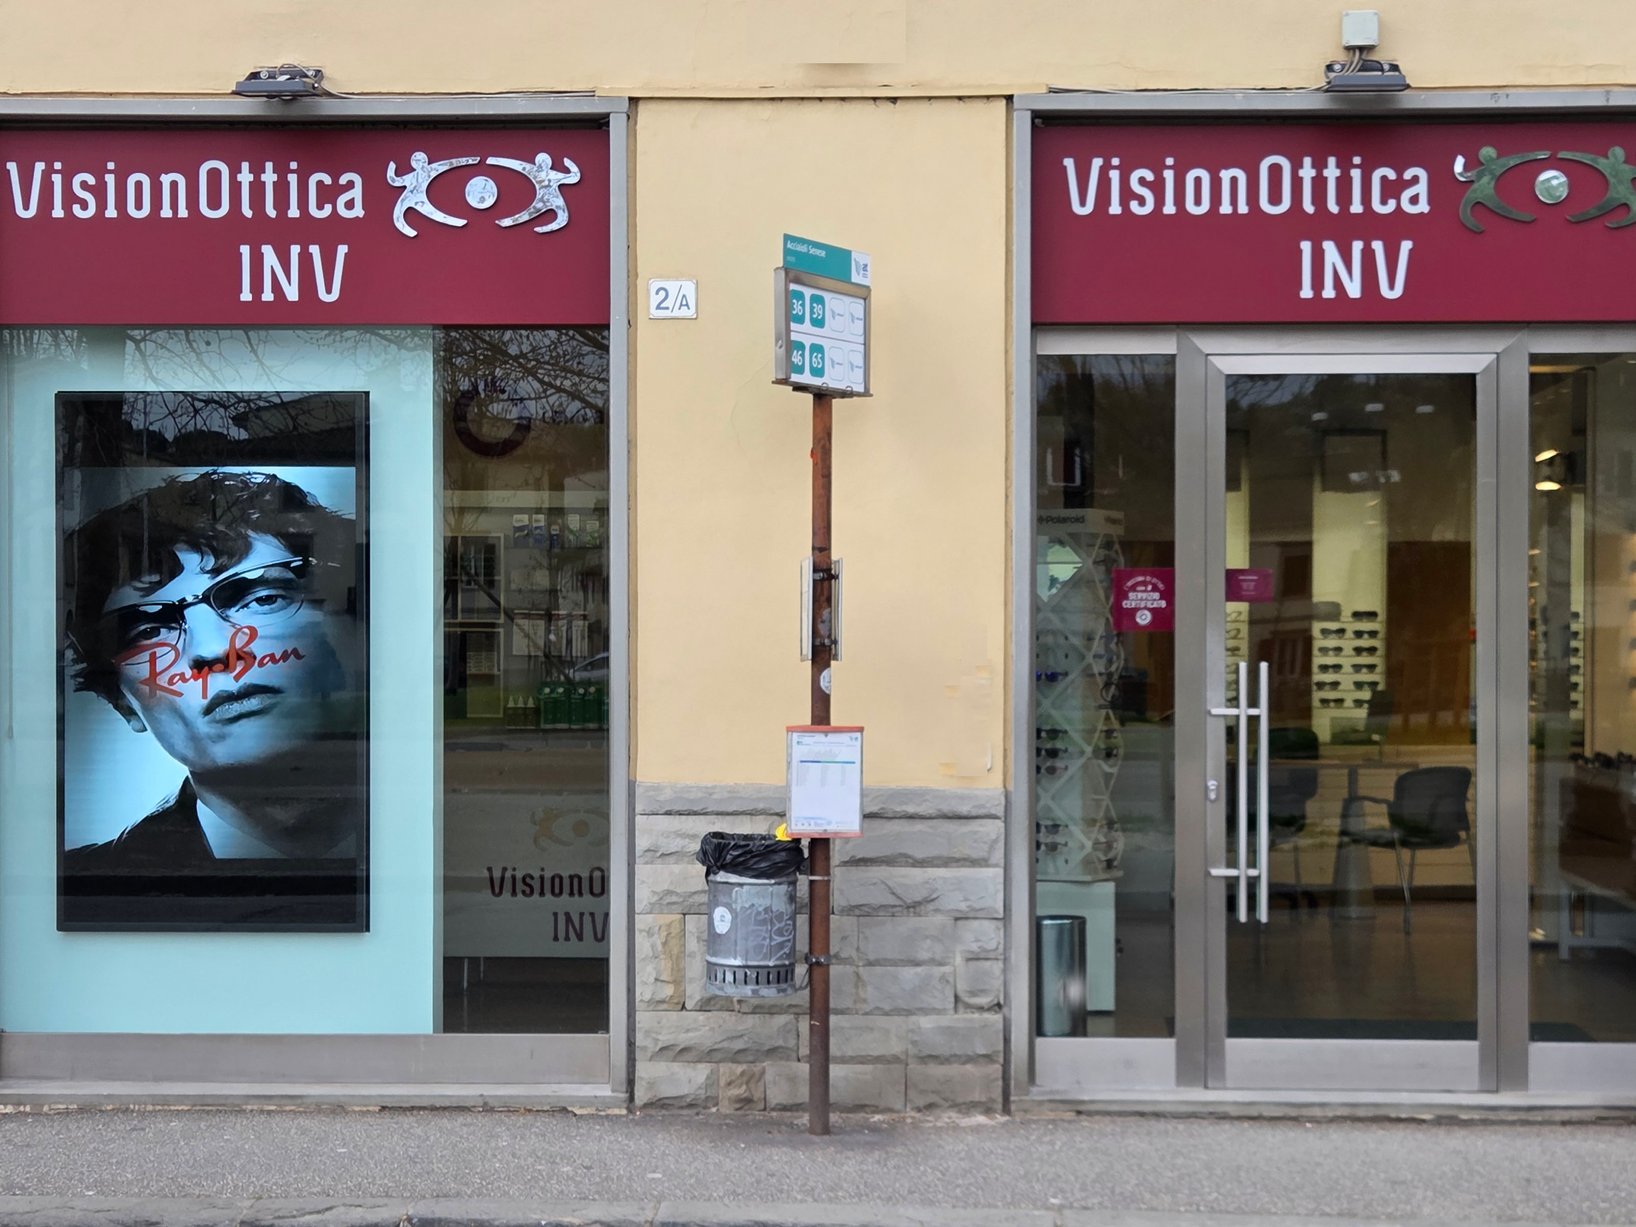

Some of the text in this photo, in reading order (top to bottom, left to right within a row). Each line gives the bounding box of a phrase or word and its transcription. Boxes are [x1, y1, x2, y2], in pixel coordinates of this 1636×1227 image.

[6, 160, 366, 219] VisionOttica
[1063, 155, 1431, 215] VisionOttica
[239, 244, 348, 302] INV
[1299, 240, 1414, 299] INV
[655, 284, 691, 313] 2/A
[792, 299, 823, 320] 36 39
[791, 349, 823, 369] 46 65
[1045, 514, 1086, 525] Polaroid
[1121, 600, 1167, 609] CERTIFICATO
[1128, 592, 1161, 601] SERVIZIO
[552, 911, 610, 943] INV
